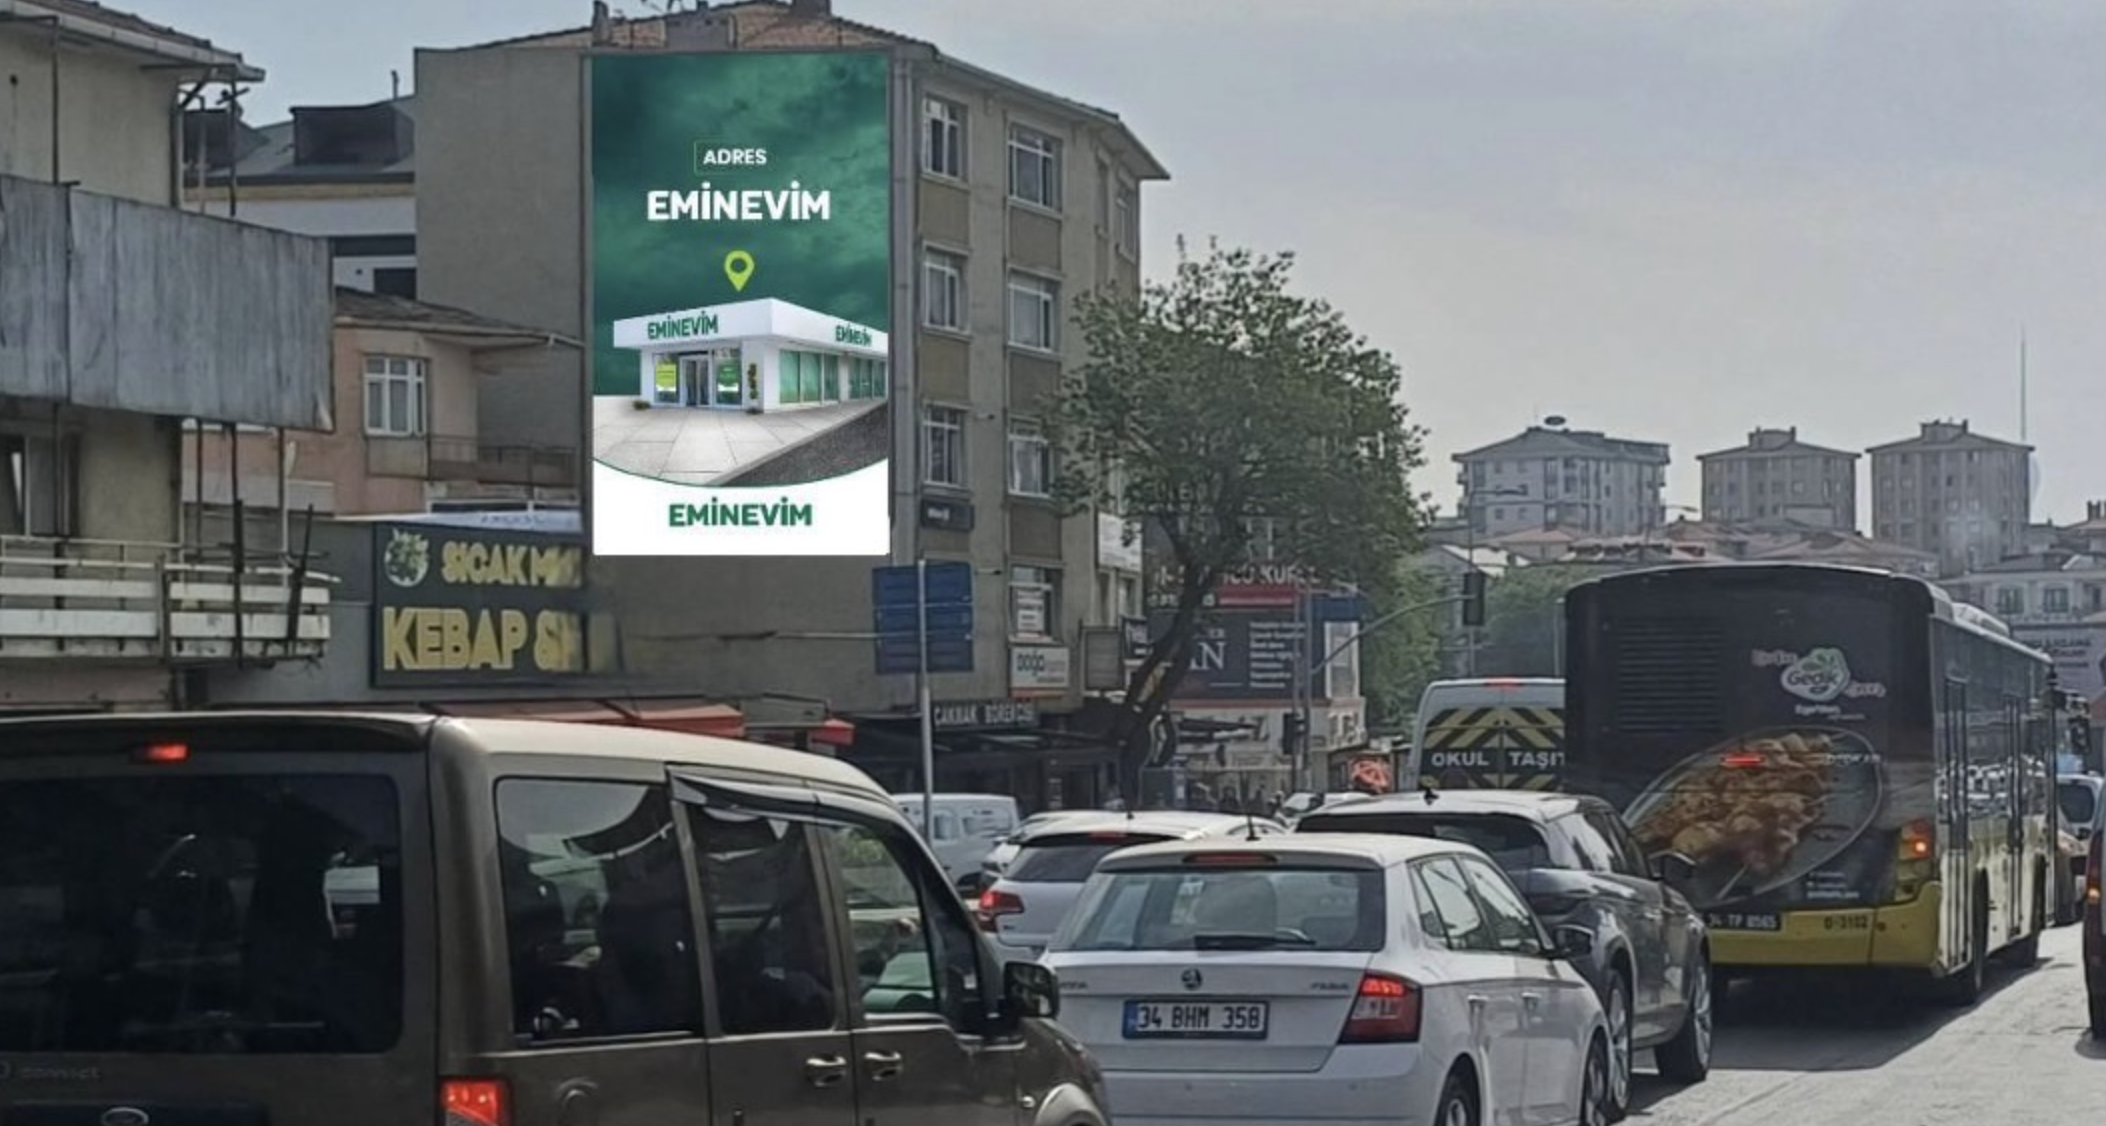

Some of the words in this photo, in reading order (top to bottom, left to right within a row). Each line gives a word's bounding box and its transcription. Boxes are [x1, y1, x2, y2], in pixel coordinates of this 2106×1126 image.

[703, 148, 767, 165] ADRES
[647, 181, 831, 220] EMİNEVİM
[647, 310, 719, 340] EMİNEVİM
[668, 496, 813, 527] EMİNEVİM
[441, 540, 529, 586] SICAK
[383, 606, 527, 670] KEBAP
[1431, 751, 1490, 767] OKUL
[1138, 1005, 1163, 1029] 34
[1171, 1005, 1210, 1029] BHM
[1222, 1005, 1260, 1029] 358
